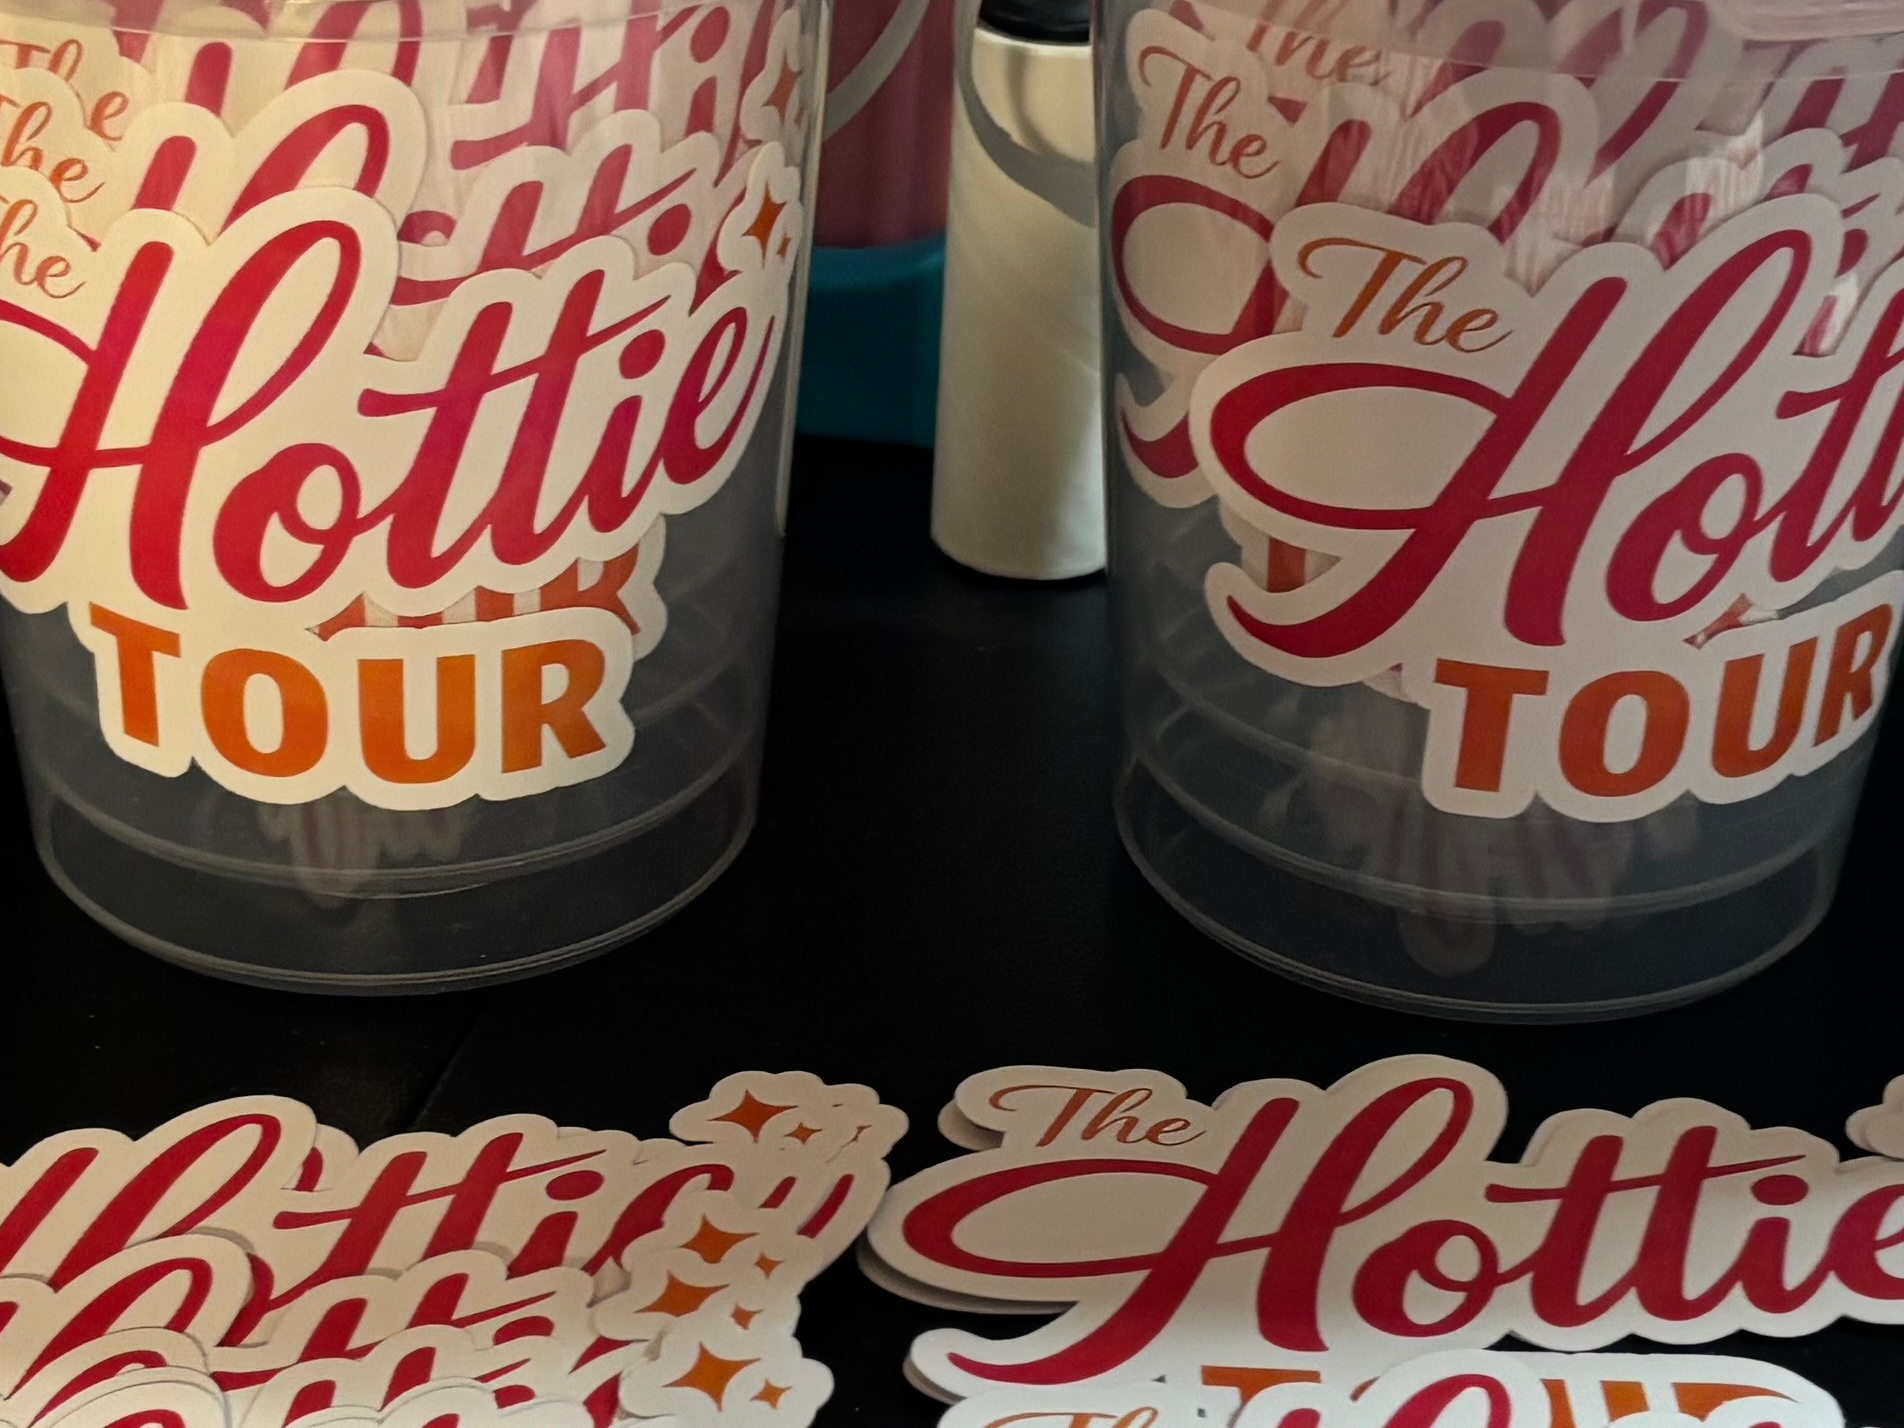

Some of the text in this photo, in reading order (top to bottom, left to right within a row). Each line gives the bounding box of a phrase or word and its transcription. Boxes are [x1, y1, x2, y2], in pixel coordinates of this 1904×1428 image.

[1138, 45, 1282, 182] The
[1298, 236, 1513, 354] The
[88, 603, 609, 785] TOUR
[1433, 602, 1894, 798] TOUR
[988, 1082, 1208, 1152] The
